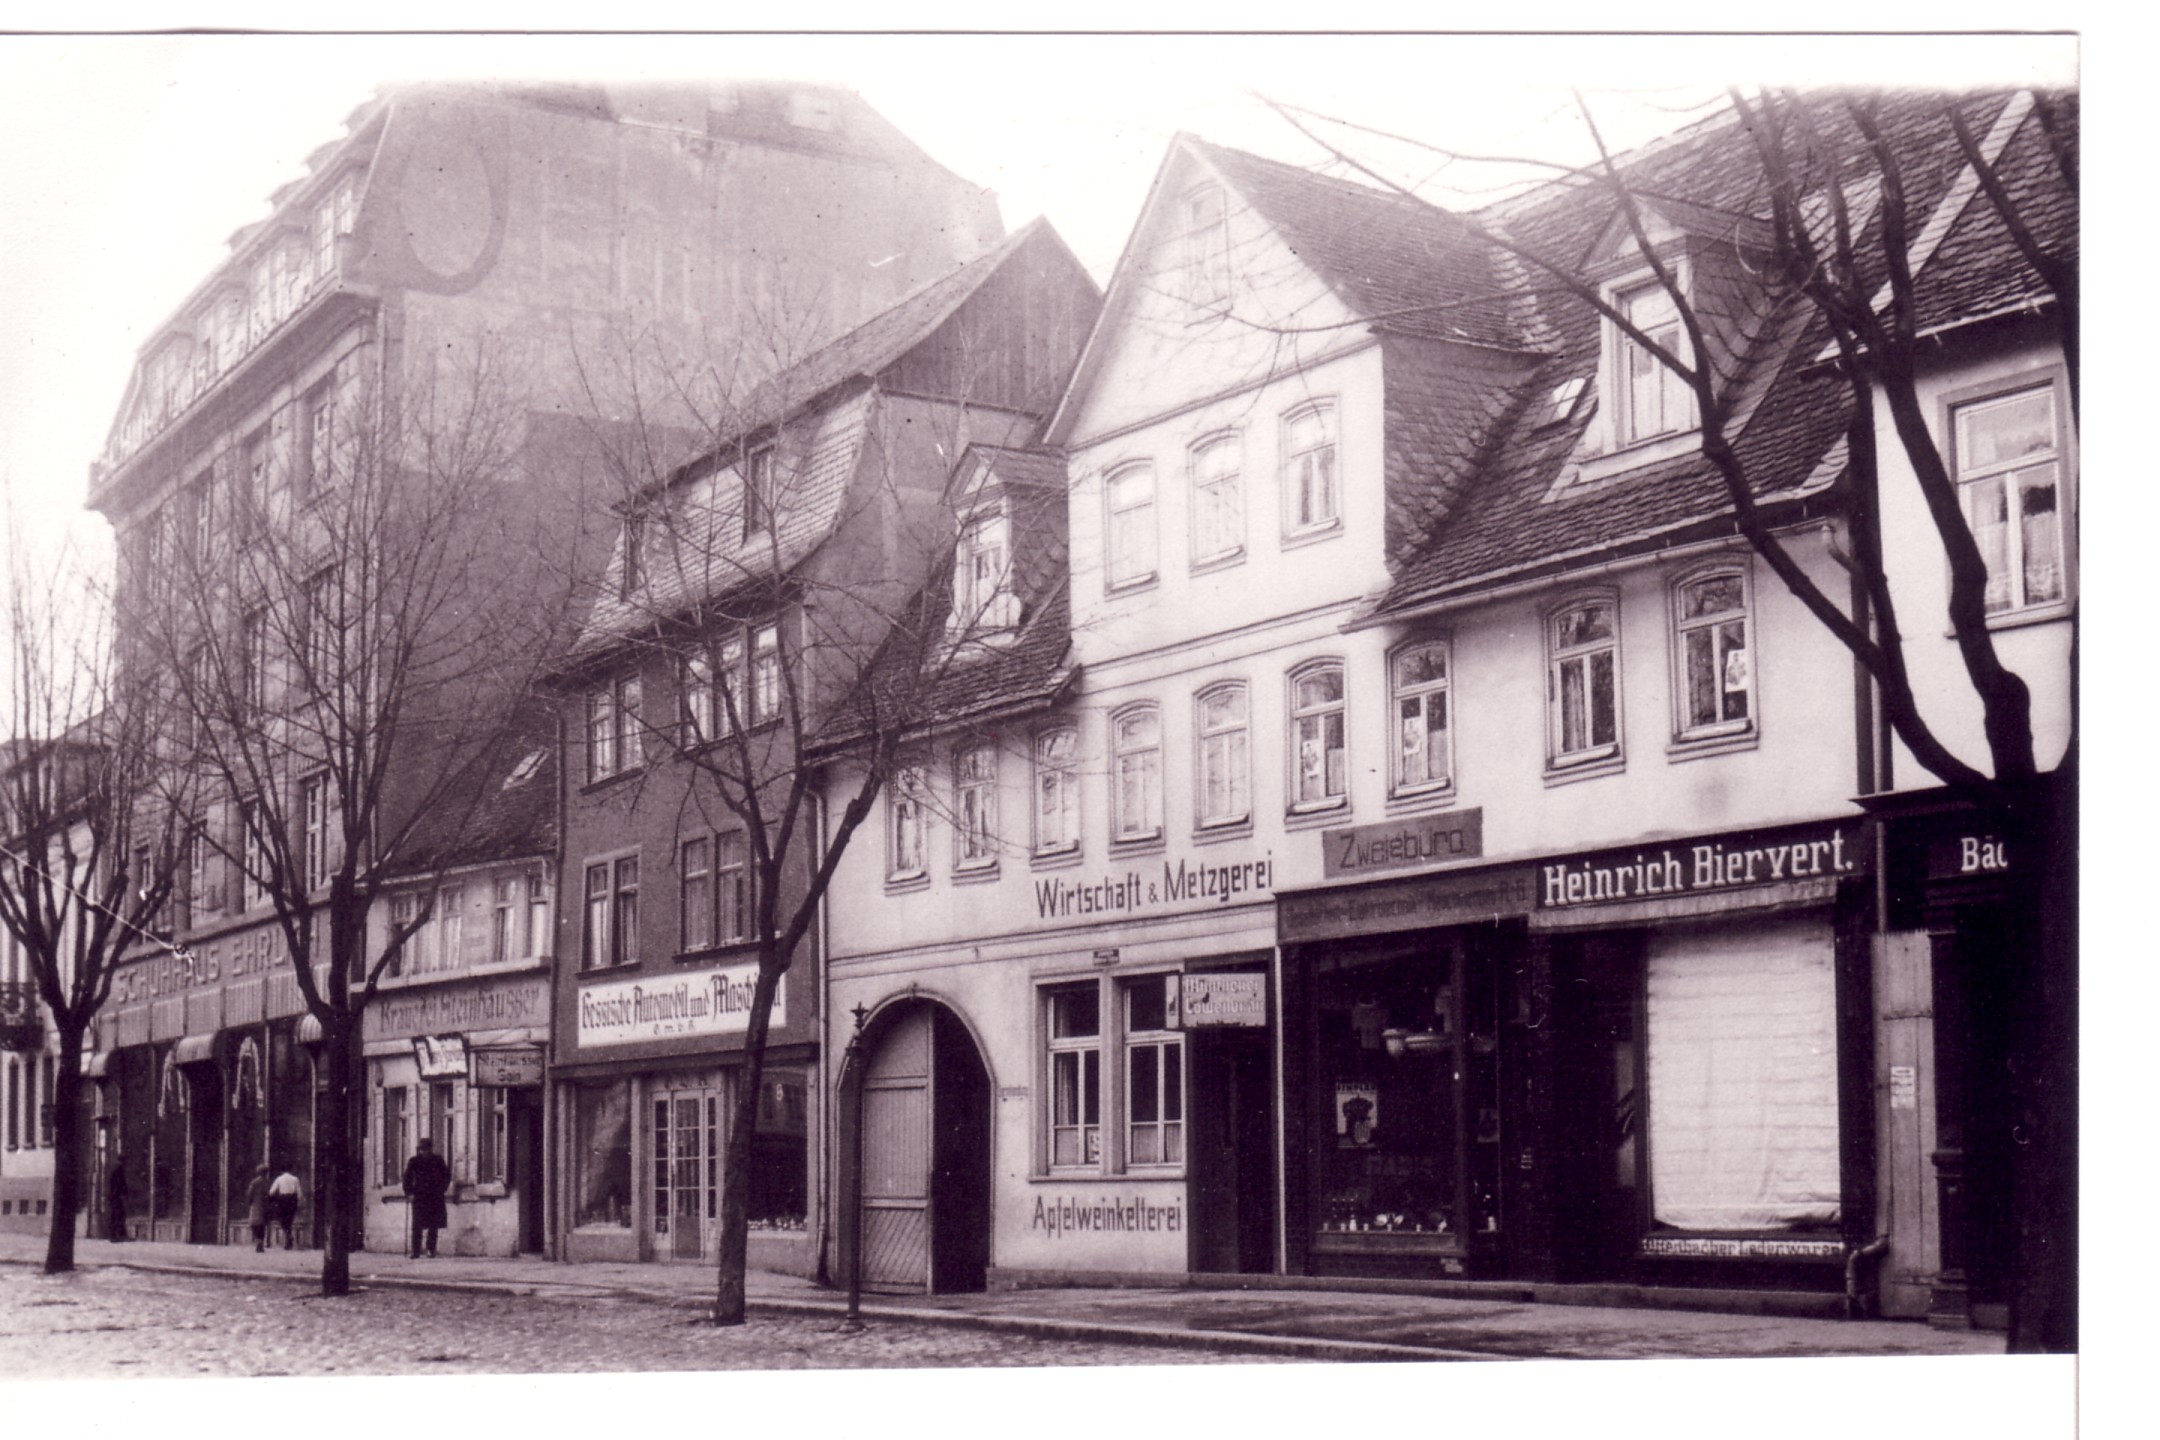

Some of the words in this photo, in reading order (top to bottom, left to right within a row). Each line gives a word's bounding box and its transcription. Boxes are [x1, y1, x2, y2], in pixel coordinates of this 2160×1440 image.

[1034, 871, 1143, 920] Wirtschaft
[1148, 881, 1160, 904] &
[1164, 848, 1273, 903] Metzgerei
[1543, 851, 1685, 907] Heinrich
[1691, 827, 1854, 889] Biervert.
[1032, 1194, 1183, 1240] Apfelweinkelterei
